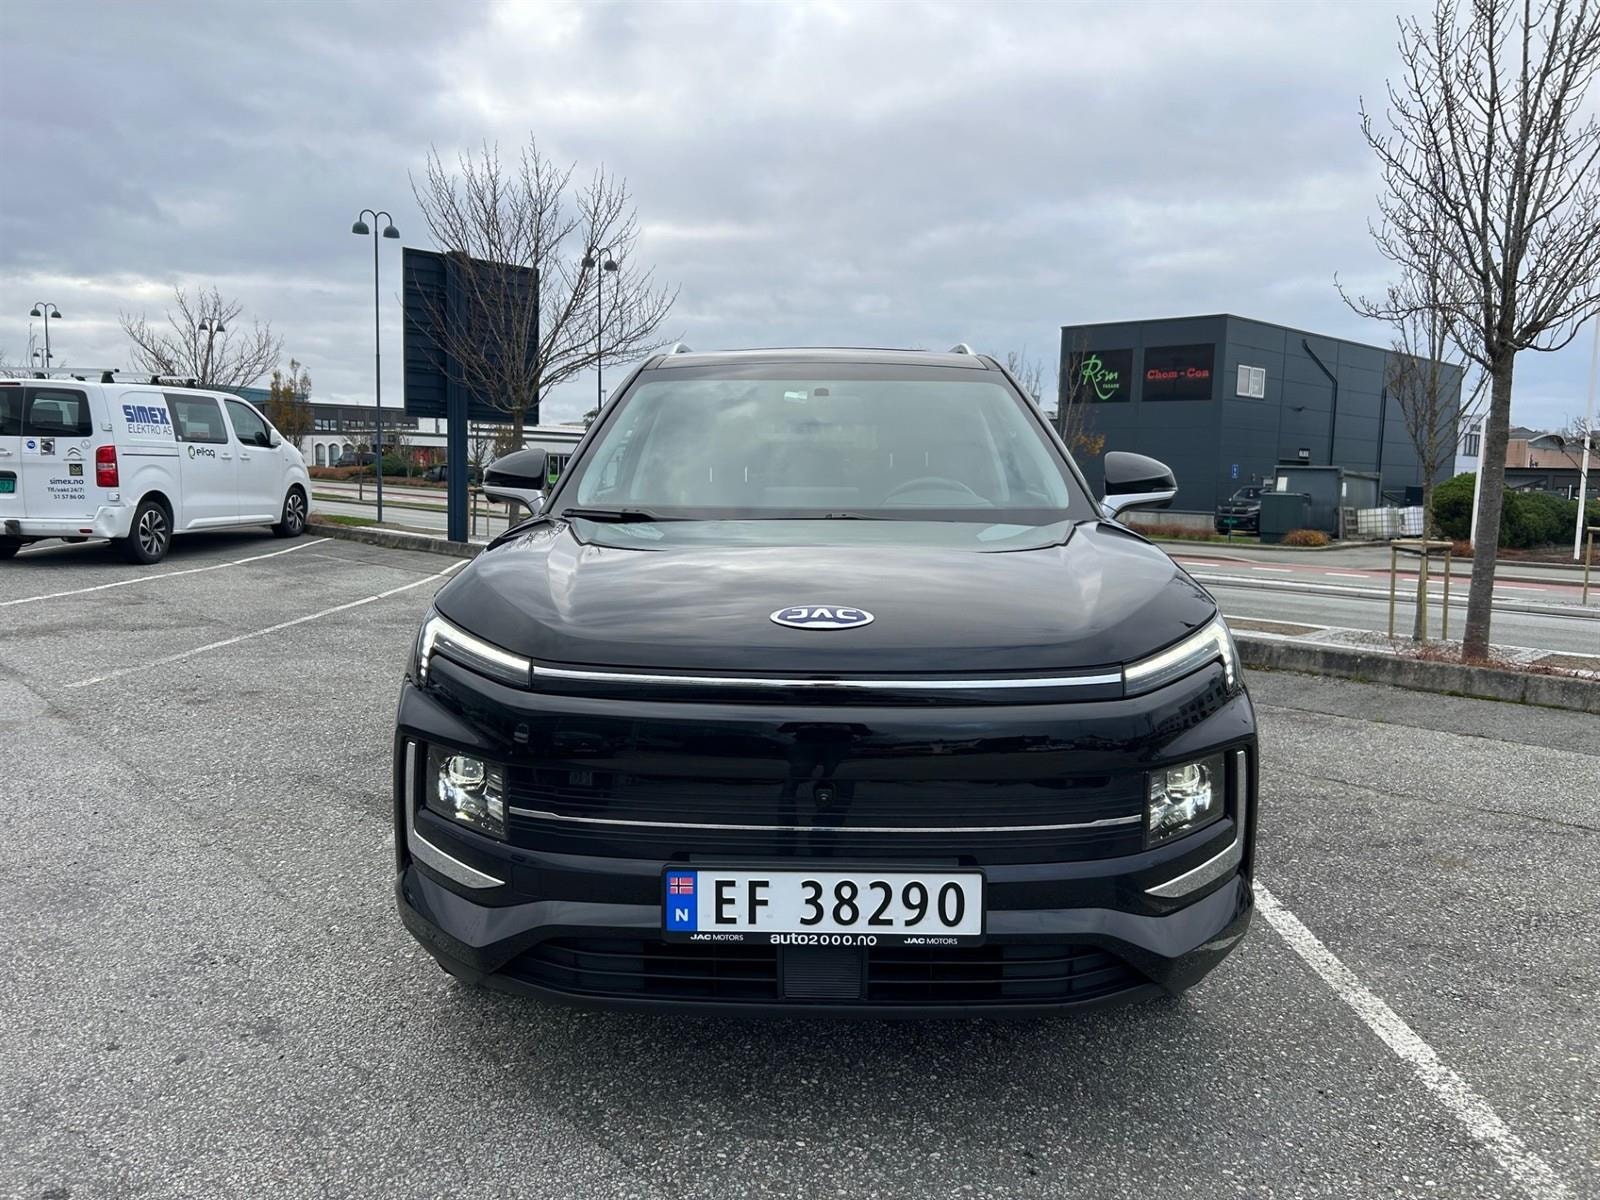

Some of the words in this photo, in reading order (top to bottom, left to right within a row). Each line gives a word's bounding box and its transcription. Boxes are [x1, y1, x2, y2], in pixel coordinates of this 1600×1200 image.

[122, 404, 171, 425] SIMEX
[128, 424, 161, 435] ELEKTRO
[163, 426, 173, 436] AS
[786, 607, 858, 620] JAC
[714, 879, 770, 925] EF
[799, 879, 966, 928] 38290
[674, 908, 690, 922] N
[690, 933, 712, 941] JAC
[769, 933, 878, 946] auto2000.no
[903, 937, 926, 945] JAC
[926, 937, 959, 945] MOTORS
